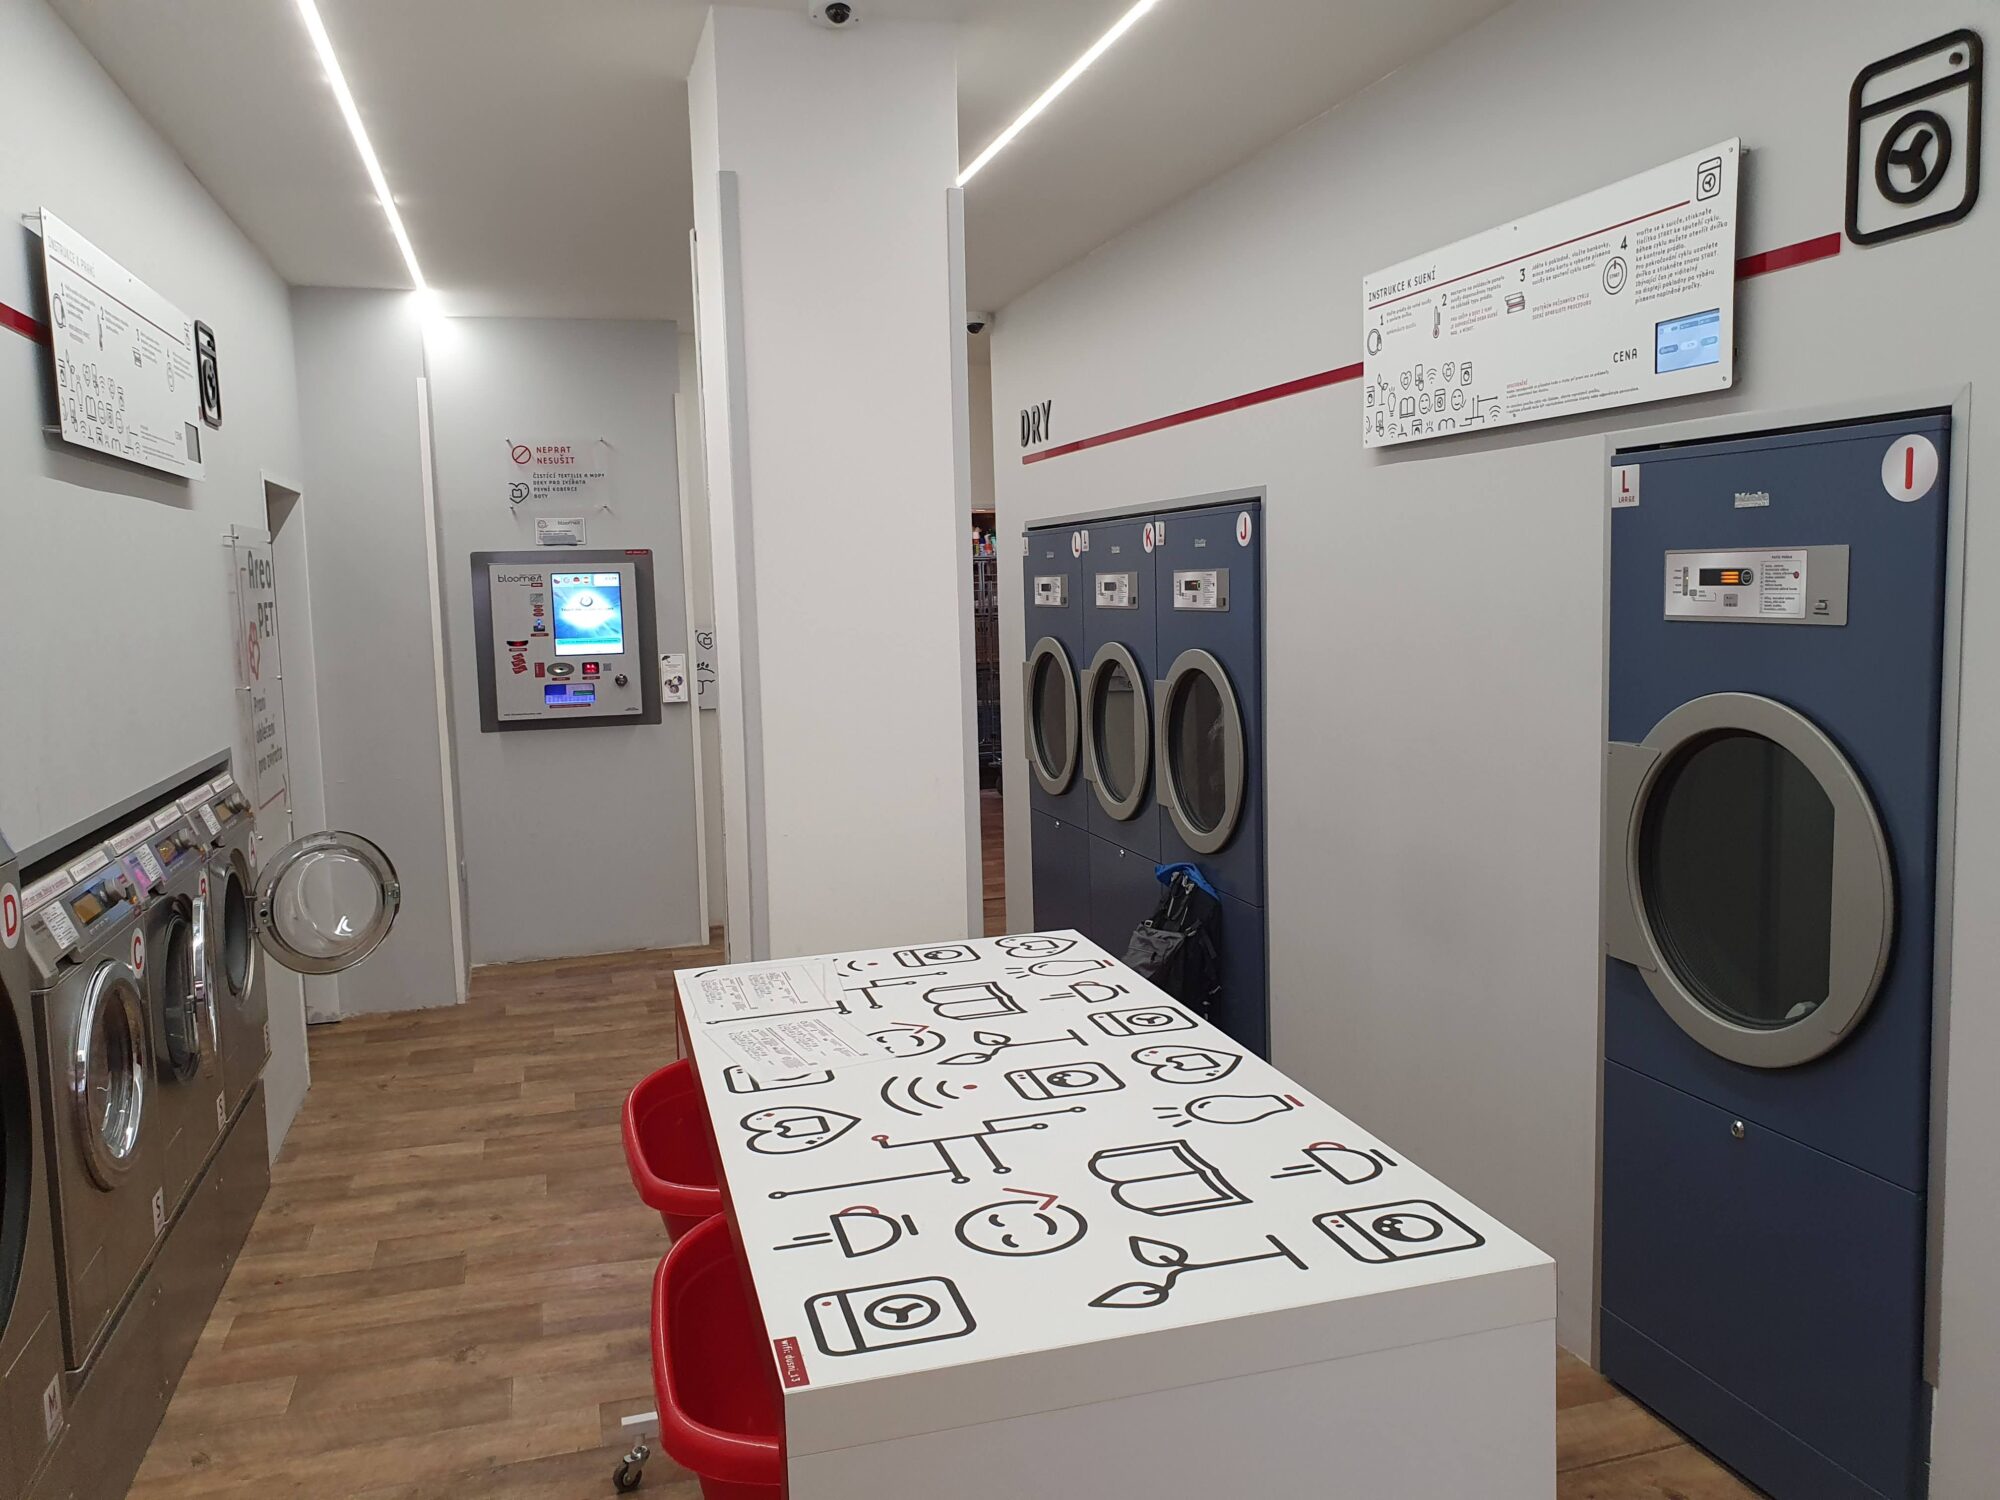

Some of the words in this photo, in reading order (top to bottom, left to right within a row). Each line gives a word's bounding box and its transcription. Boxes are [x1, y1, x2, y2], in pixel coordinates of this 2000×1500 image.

[1621, 235, 1627, 250] 4
[1658, 229, 1672, 239] START
[1369, 280, 1405, 302] INSTRUKCE
[1407, 279, 1412, 288] K
[1414, 265, 1436, 286] SUENÍ
[1520, 268, 1525, 282] 3
[1442, 294, 1447, 307] 2
[1380, 314, 1383, 326] 1
[1613, 348, 1638, 363] CENA
[1020, 399, 1052, 448] DRY
[537, 454, 575, 464] NESUŠIT
[1622, 470, 1629, 493] L
[1241, 517, 1246, 539] J
[1074, 535, 1079, 552] L
[1146, 528, 1152, 547] K
[498, 574, 542, 582] bloomest
[257, 602, 274, 639] PET
[4, 894, 17, 939] D
[133, 935, 143, 969] C
[156, 1196, 160, 1219] S
[781, 1340, 792, 1354] wifi:
